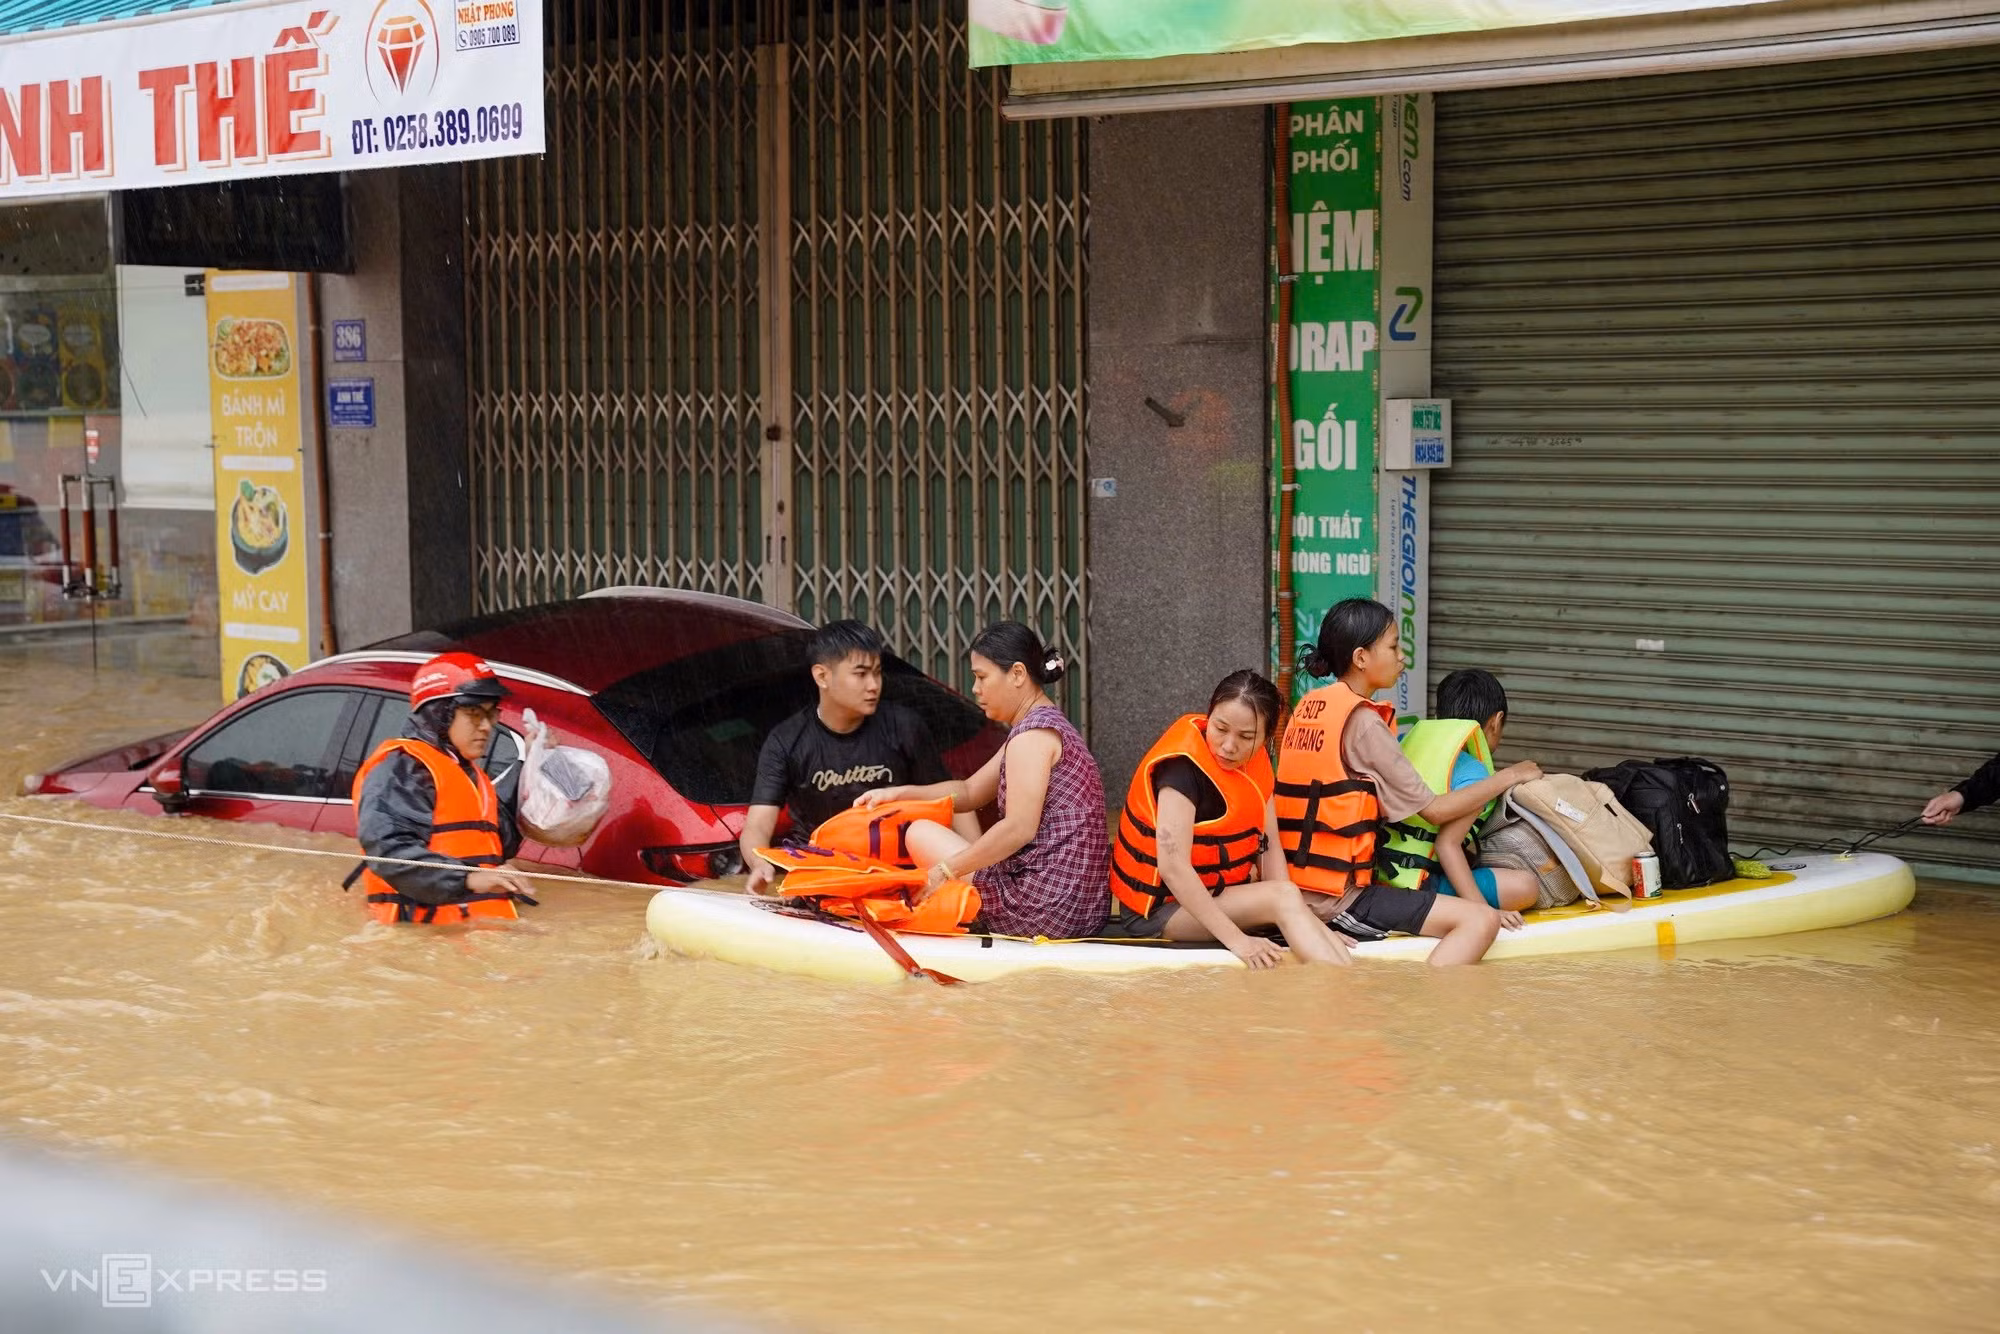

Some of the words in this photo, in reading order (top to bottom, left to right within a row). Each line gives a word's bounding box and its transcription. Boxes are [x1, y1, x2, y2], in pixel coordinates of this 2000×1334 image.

[138, 10, 324, 167] THẾ
[352, 119, 379, 154] ĐT:
[384, 102, 522, 152] 0258.389.0699
[1289, 105, 1364, 138] PHÂN
[1292, 139, 1359, 174] PHỐI
[1293, 402, 1358, 471] GỐI
[1318, 509, 1363, 539] THẤT
[1292, 548, 1332, 575] ÒNG
[257, 590, 289, 613] CAY
